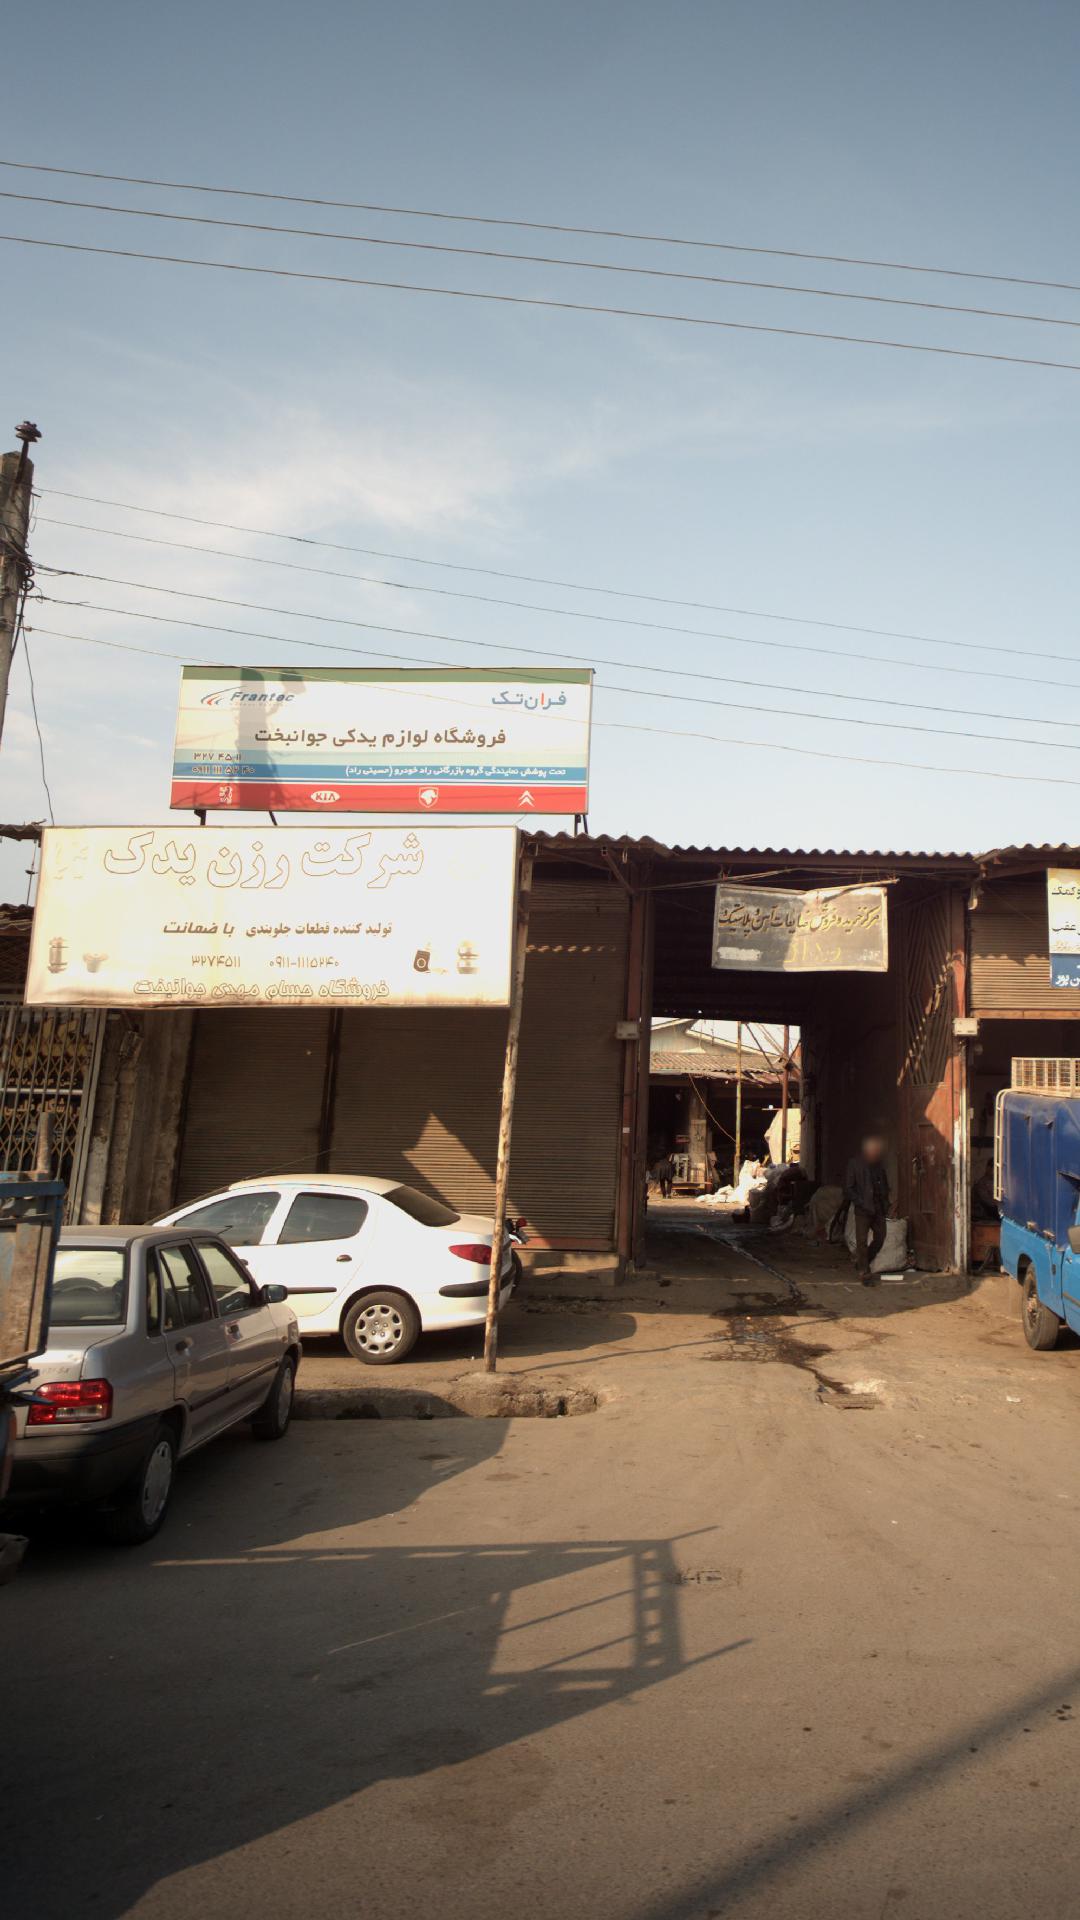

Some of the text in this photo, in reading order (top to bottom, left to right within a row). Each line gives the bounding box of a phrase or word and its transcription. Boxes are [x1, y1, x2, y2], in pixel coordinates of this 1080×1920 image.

[255, 727, 507, 747] فروشگاه لوازم یدکی جوانبخت
[433, 766, 464, 776] بازرگانی
[465, 767, 483, 775] گروه
[485, 768, 518, 776] نمایندگی
[520, 768, 546, 778] پوشش
[315, 791, 336, 801] KIA
[104, 830, 198, 887] یدک
[300, 831, 425, 889] شرکت
[162, 920, 392, 938] تولید کننده قطعات جلوبندی با ضمانت
[191, 954, 241, 968] ۳۲۷۴۵۱۱
[133, 978, 205, 999] جوانبخت
[265, 978, 314, 1000] حسام
[319, 977, 390, 1000] فروشگاه
